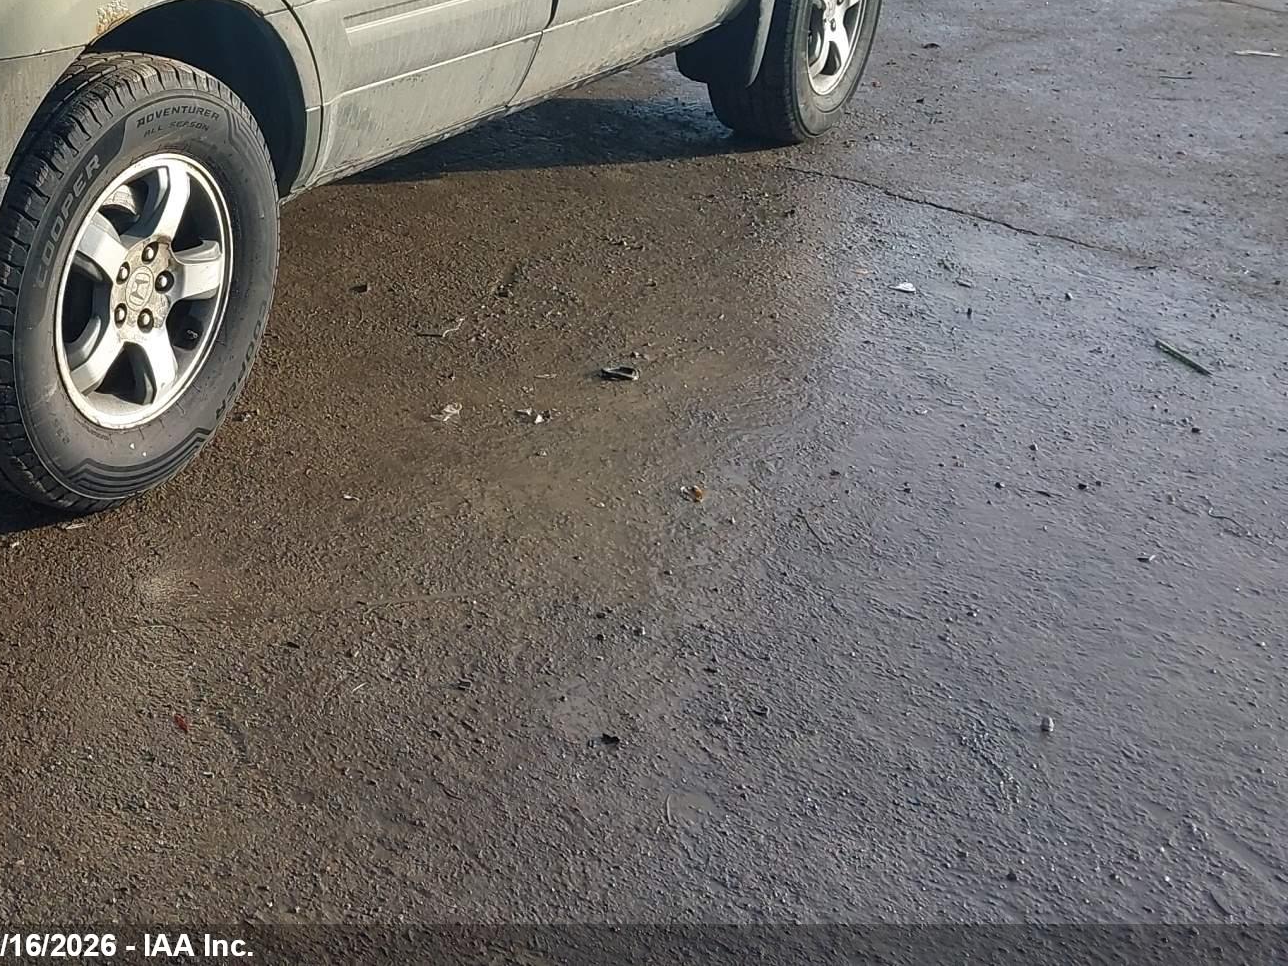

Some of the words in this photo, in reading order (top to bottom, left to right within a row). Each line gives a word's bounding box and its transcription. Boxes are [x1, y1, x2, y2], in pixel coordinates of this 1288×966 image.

[136, 106, 219, 128] ADVENTURER
[143, 125, 163, 138] ALL
[34, 154, 101, 288] COOPER
